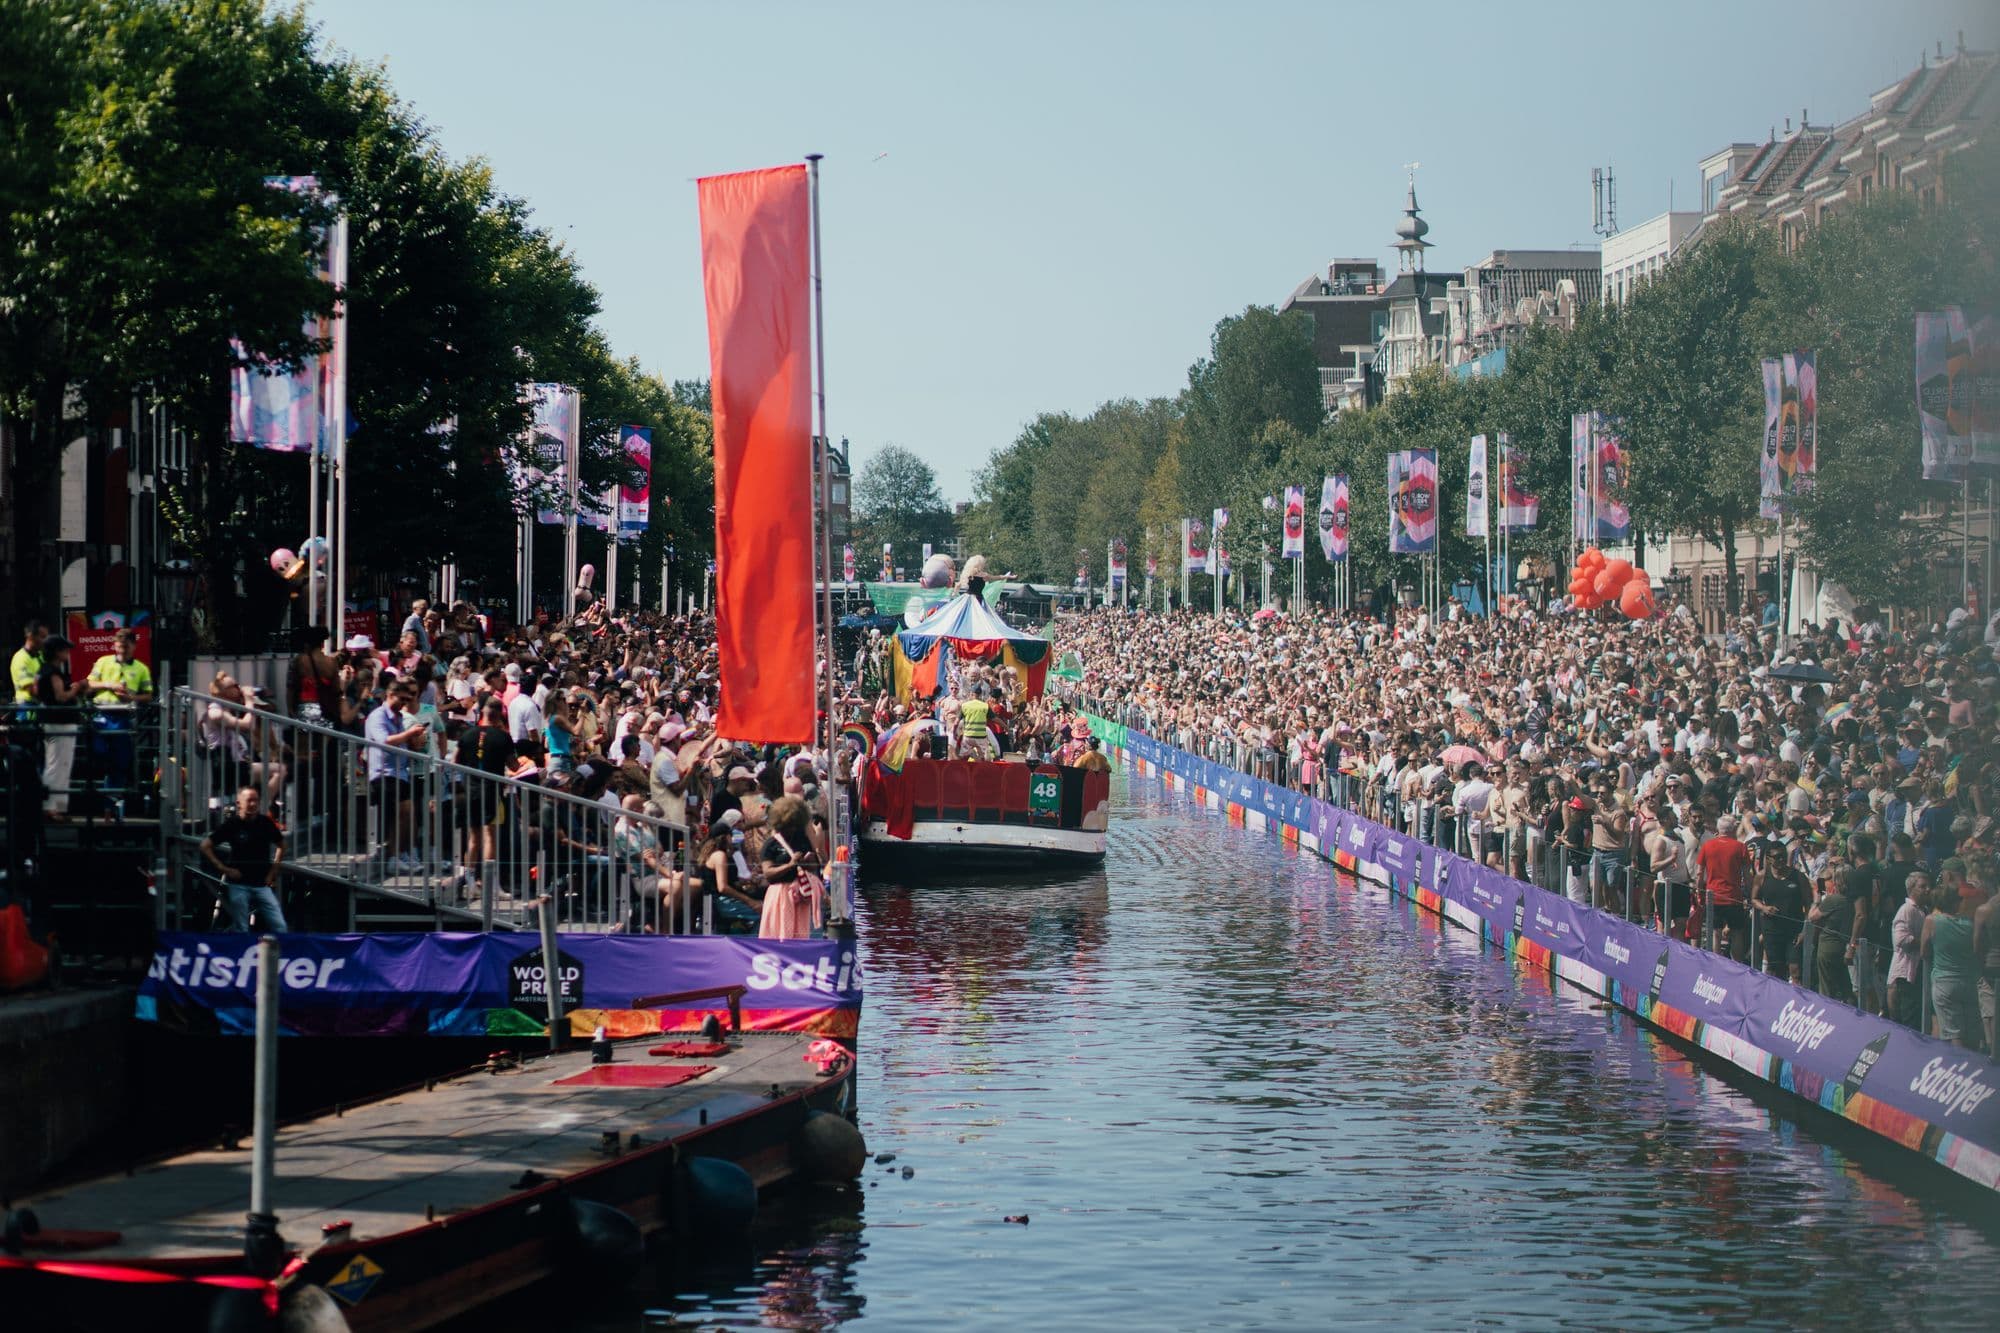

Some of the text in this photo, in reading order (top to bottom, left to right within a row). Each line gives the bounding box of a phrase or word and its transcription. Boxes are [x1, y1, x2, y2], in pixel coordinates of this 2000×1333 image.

[1033, 782, 1057, 798] 48
[513, 966, 580, 981] WOLD
[520, 981, 571, 995] PRIE
[1770, 1000, 1836, 1053] Satisfyer
[1909, 1056, 1997, 1117] Satisfyer
